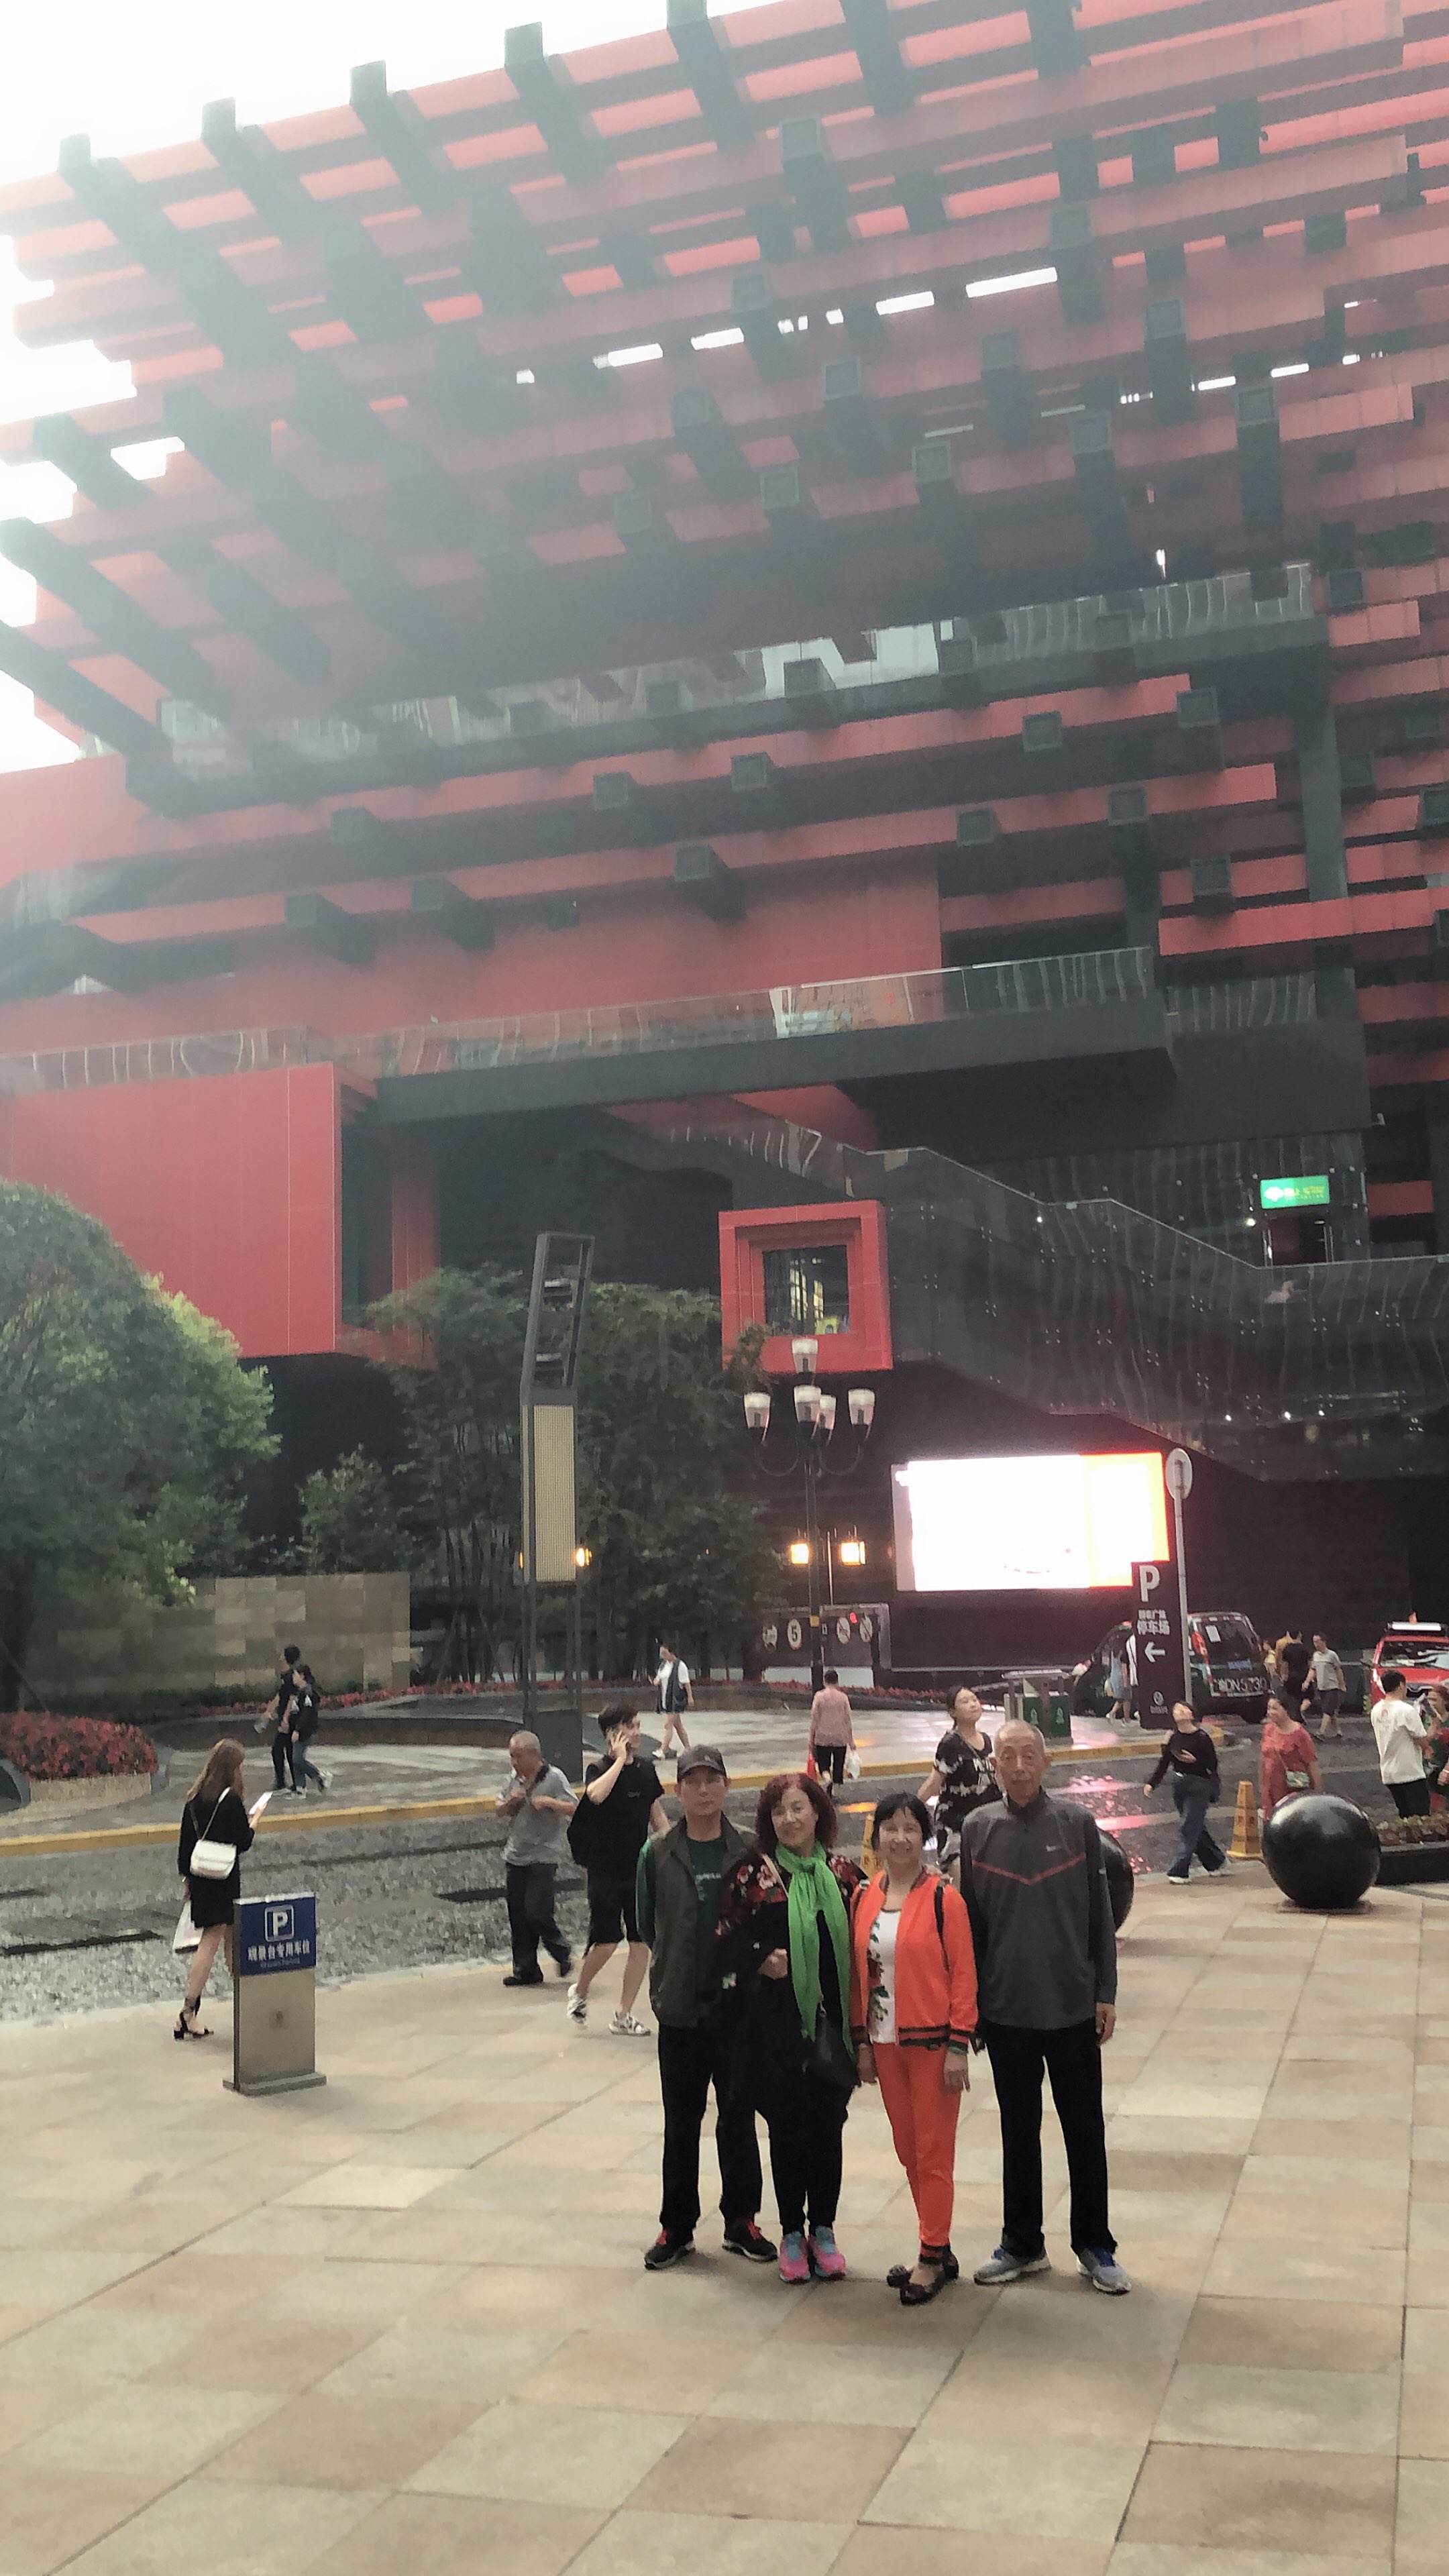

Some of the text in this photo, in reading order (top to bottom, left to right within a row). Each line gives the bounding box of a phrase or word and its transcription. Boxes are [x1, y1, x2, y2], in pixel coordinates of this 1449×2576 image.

[1139, 1564, 1160, 1602] P
[1136, 1619, 1171, 1635] 停车场
[272, 1911, 288, 1937] P
